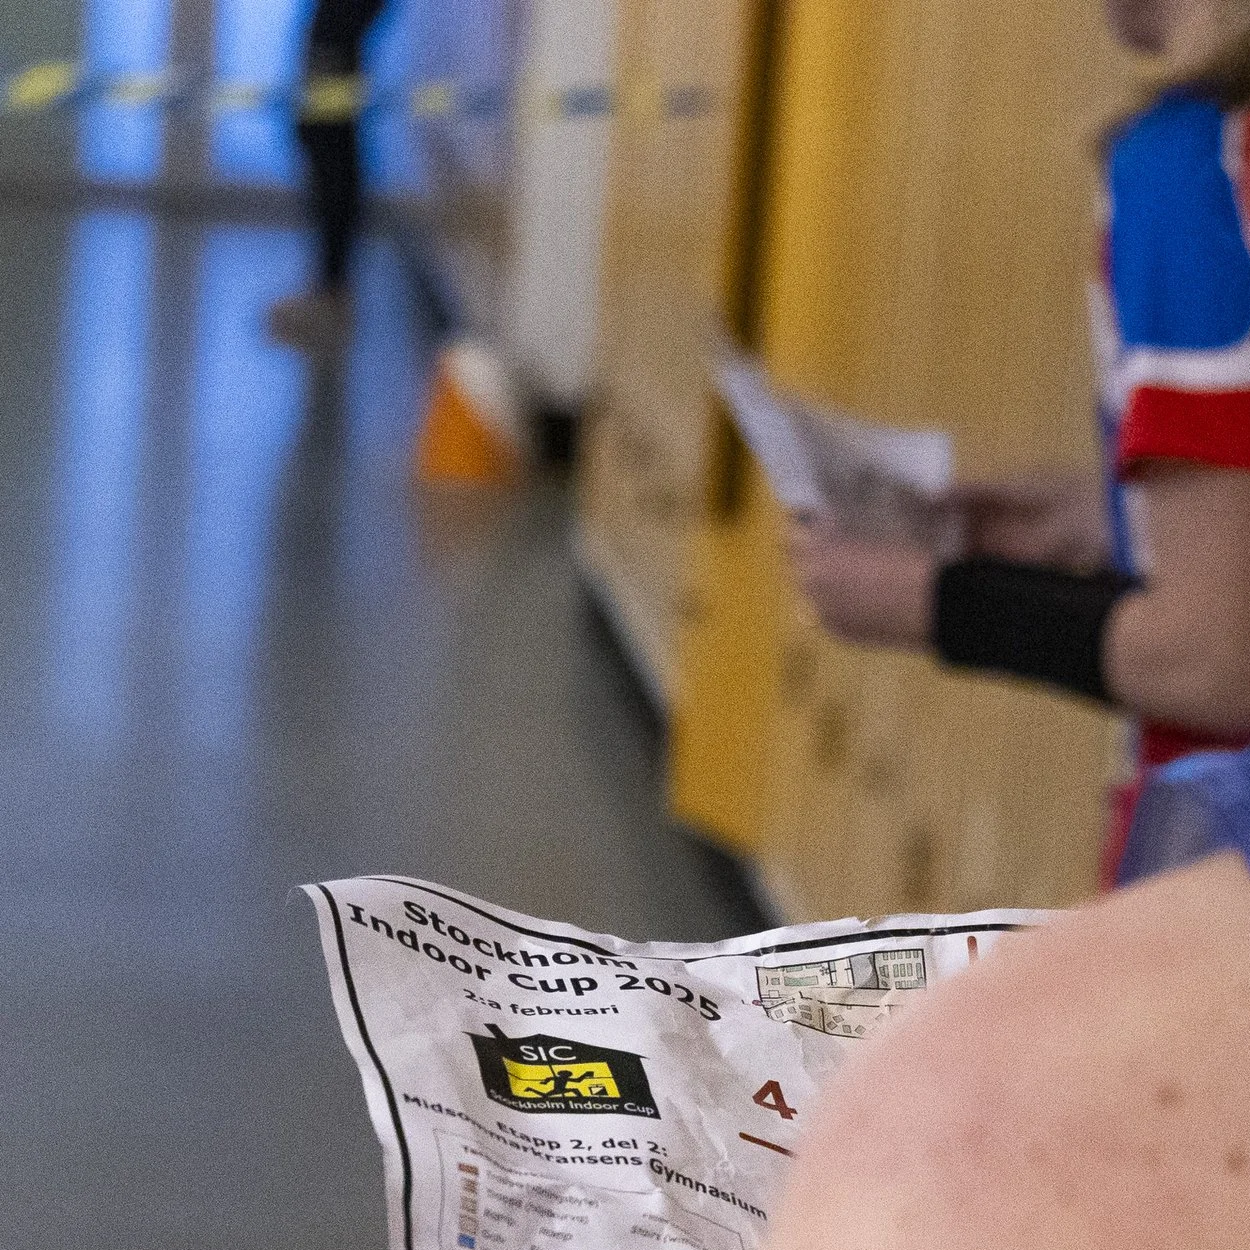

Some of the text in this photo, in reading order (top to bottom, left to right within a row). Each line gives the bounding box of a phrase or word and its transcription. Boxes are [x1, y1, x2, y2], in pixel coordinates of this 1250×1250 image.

[403, 900, 639, 971] Stockholm
[346, 902, 722, 1021] Indoor Cup 2025
[463, 988, 620, 1017] 2:a februari
[519, 1045, 577, 1062] SIC
[568, 1099, 620, 1112] Indoor
[623, 1102, 655, 1117] Cup
[752, 1079, 799, 1121] 4
[496, 1120, 561, 1151] Etapp
[601, 1137, 638, 1150] del
[649, 1157, 768, 1221] Gymnasium
